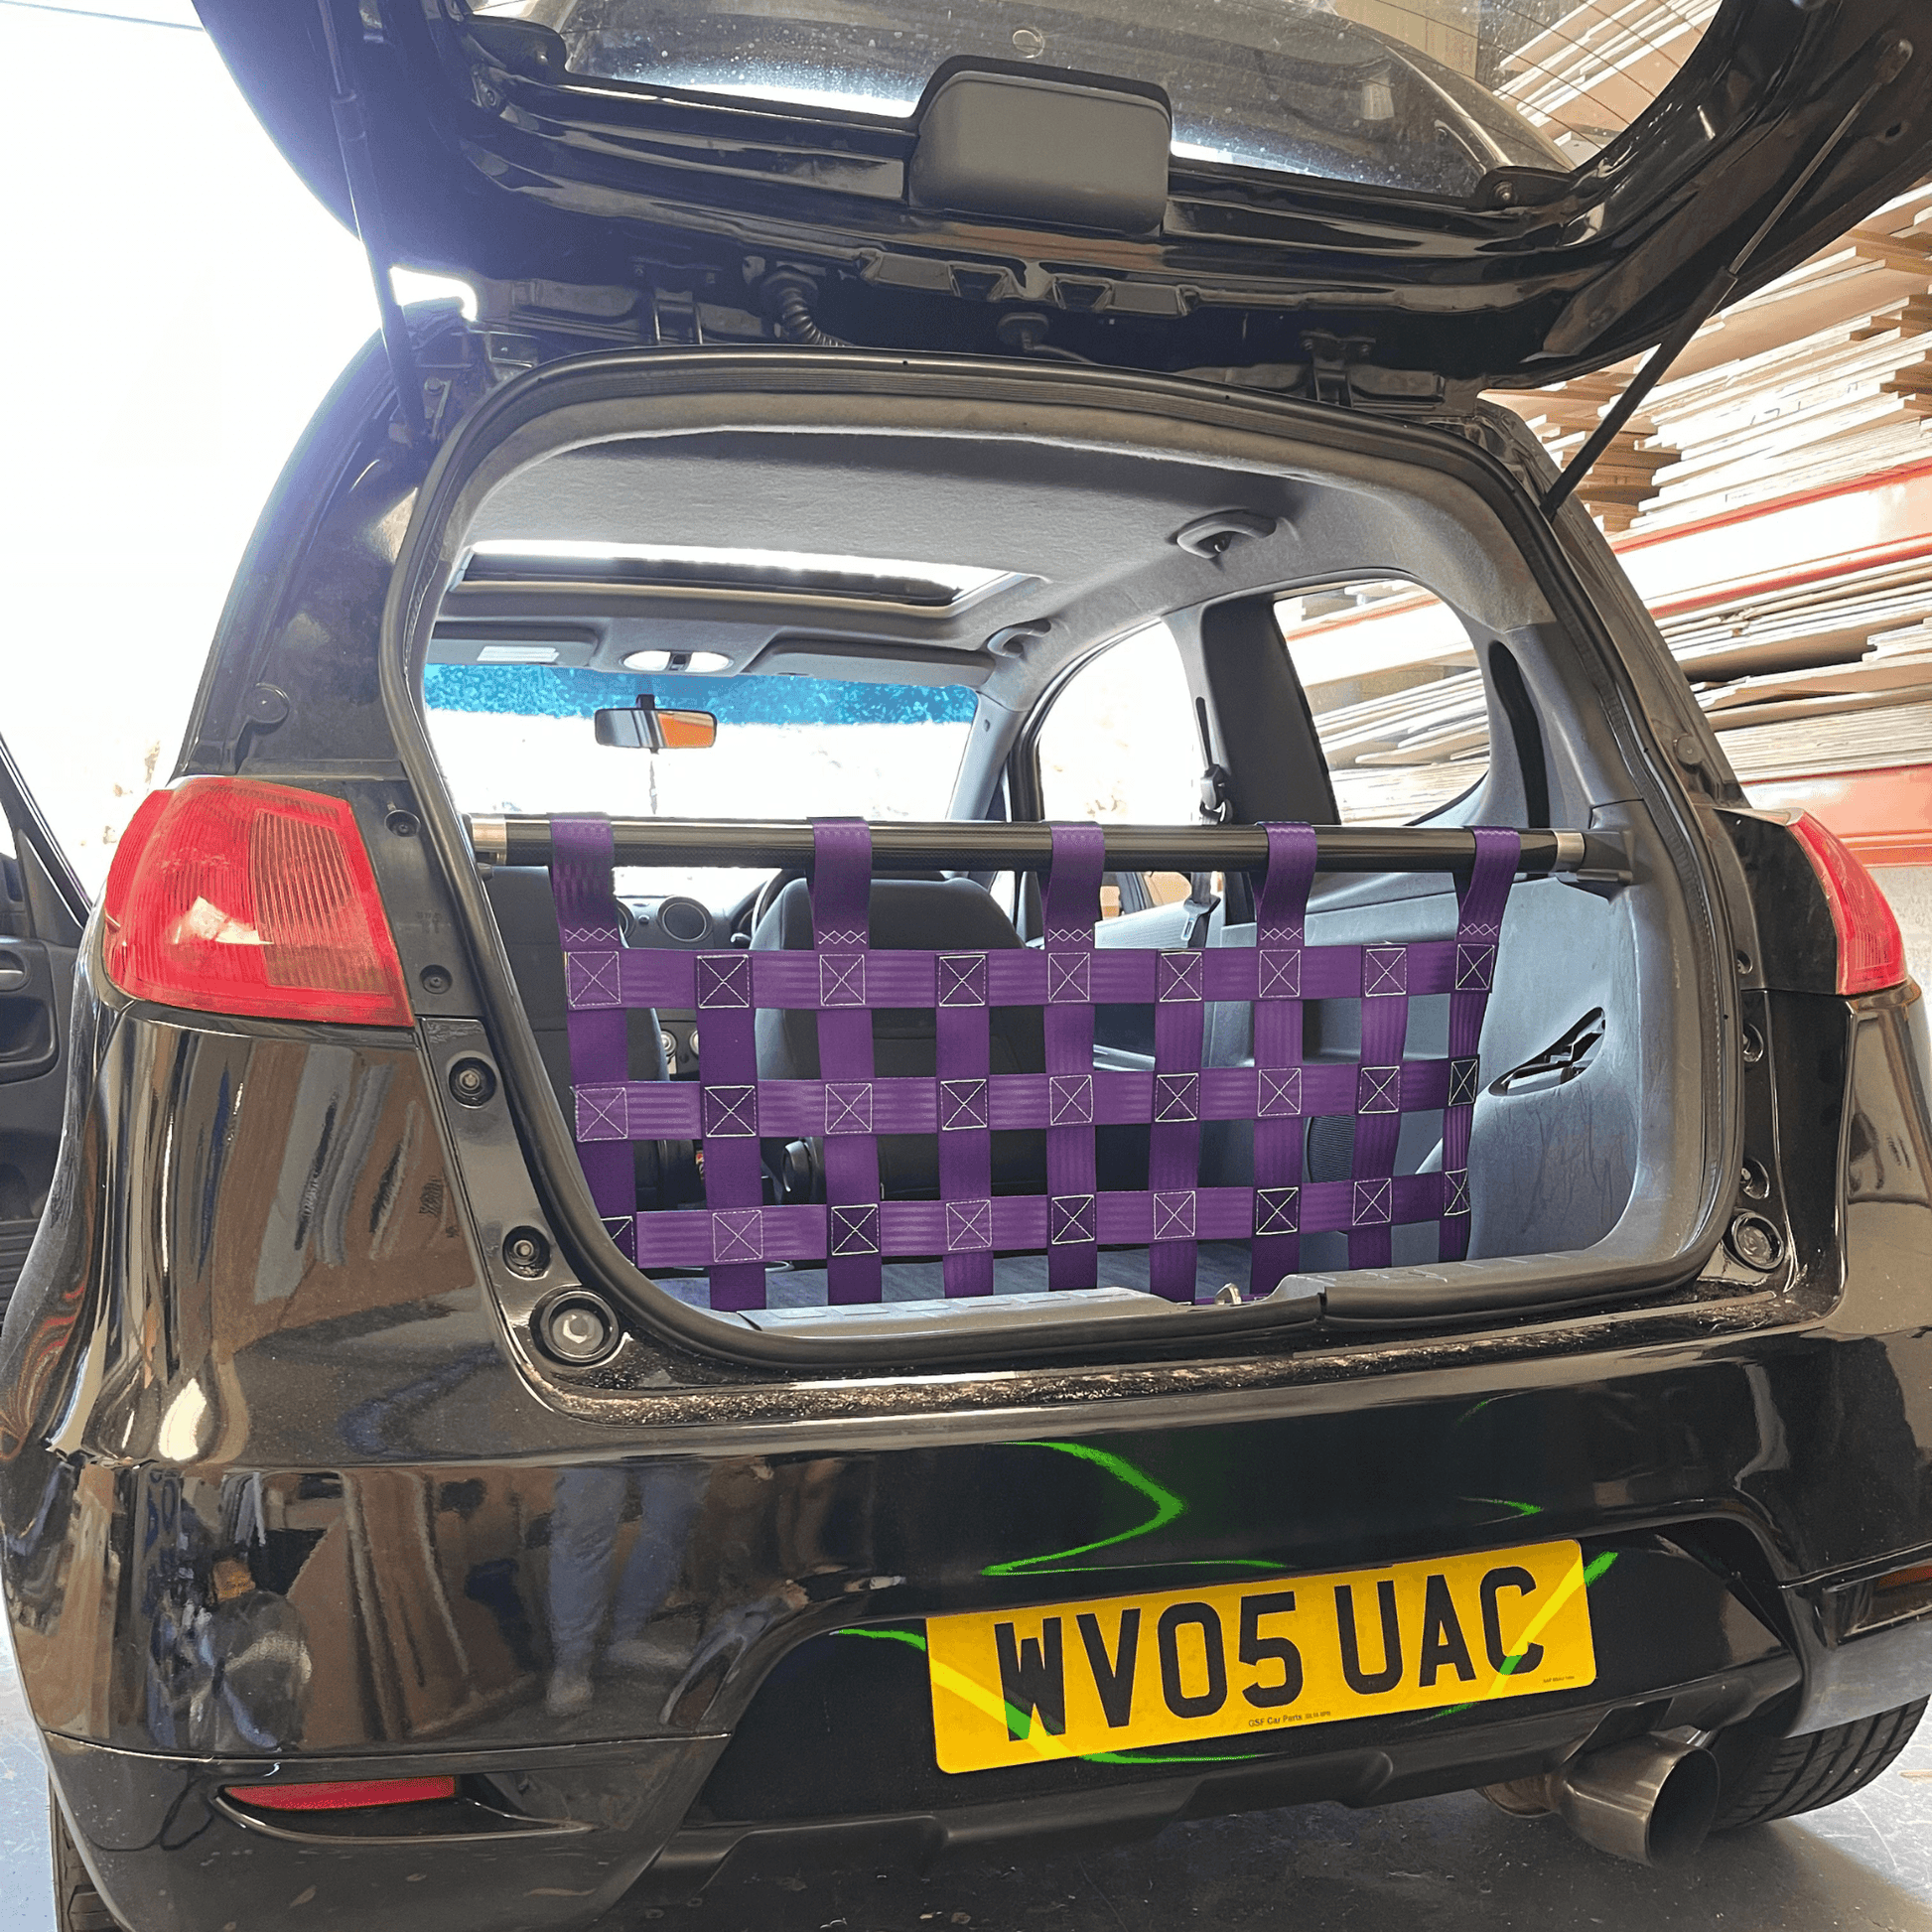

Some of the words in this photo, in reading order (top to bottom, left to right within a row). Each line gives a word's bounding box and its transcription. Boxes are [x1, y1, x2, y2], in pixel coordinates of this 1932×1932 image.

[994, 1591, 1304, 1741] WV05
[1333, 1566, 1545, 1696] UAC
[1248, 1718, 1265, 1727] GSF
[1283, 1714, 1303, 1723] Parts
